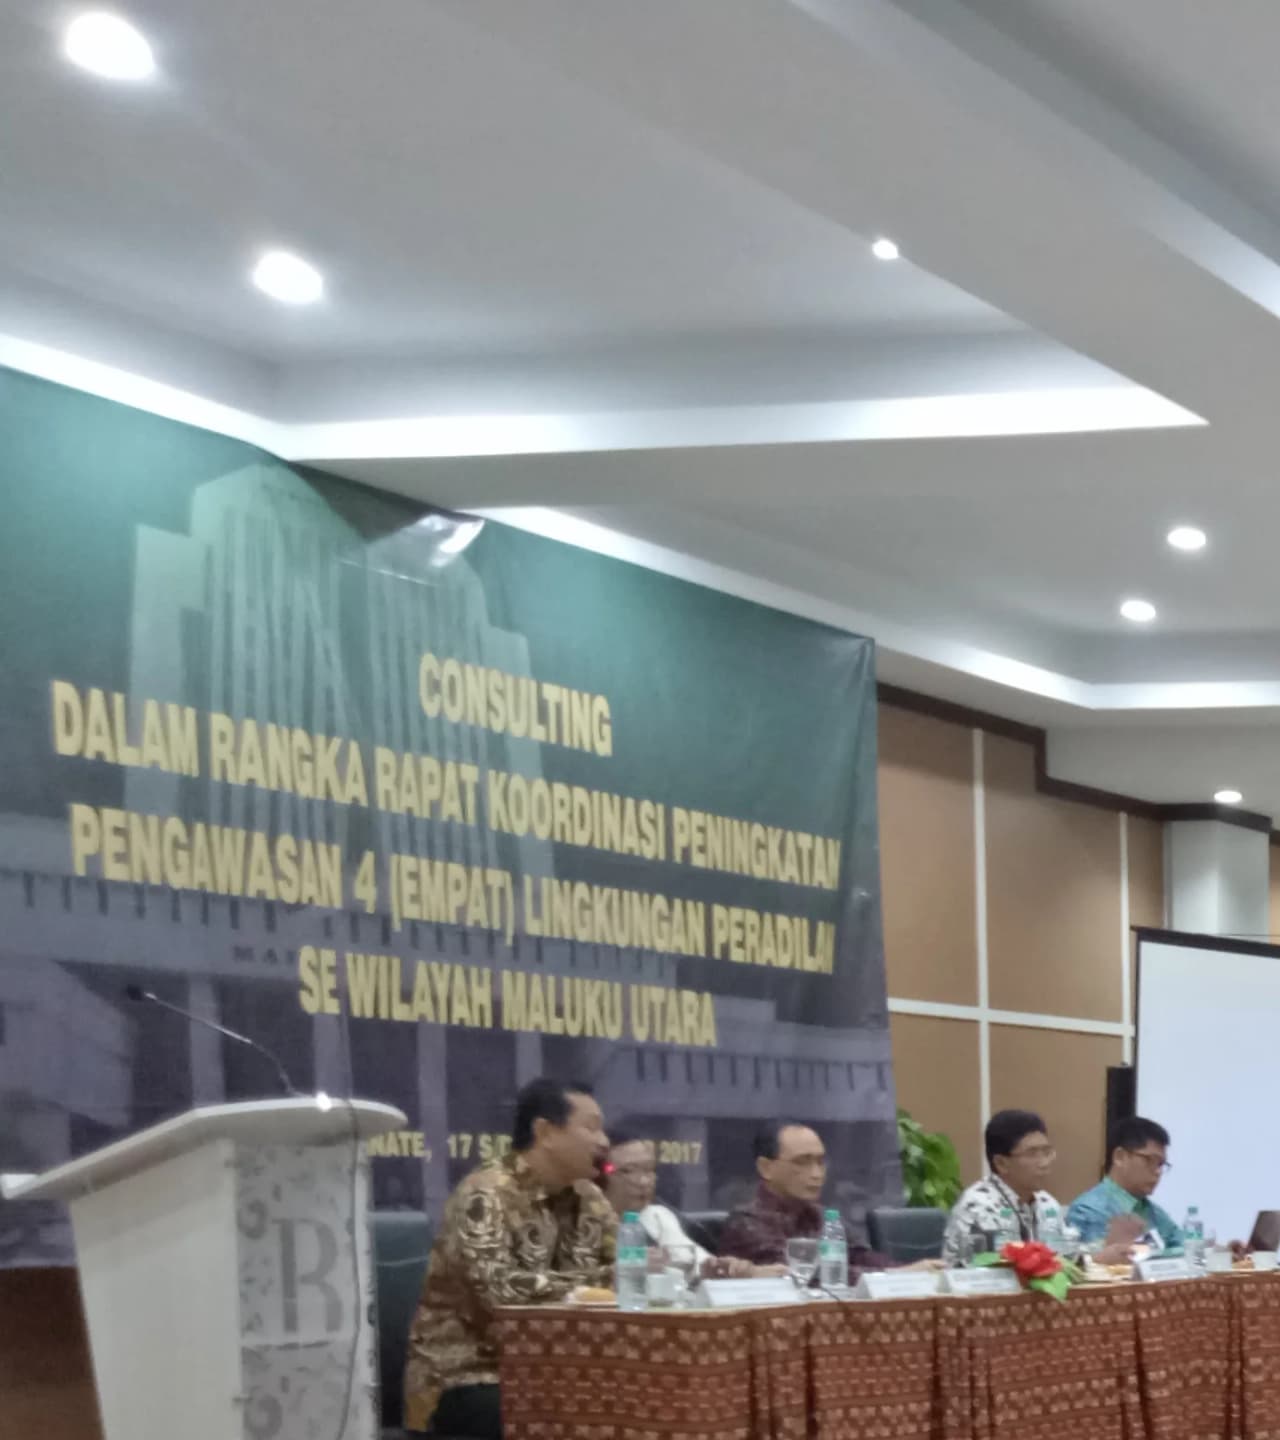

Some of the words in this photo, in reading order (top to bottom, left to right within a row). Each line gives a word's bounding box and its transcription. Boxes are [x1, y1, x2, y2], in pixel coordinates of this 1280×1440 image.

[419, 652, 612, 757] CONSULTING
[51, 679, 199, 777] DALAM
[209, 711, 369, 807] RANGKA
[373, 746, 479, 826] RAPAT
[487, 769, 667, 861] KOORDINASI
[672, 806, 842, 891] PENINGKATAN
[69, 803, 343, 909] PENGAWASAN
[352, 850, 377, 914] 4
[390, 853, 515, 947] (EMPAT)
[523, 874, 706, 957] LINGKUNGAN
[712, 903, 837, 976] PERADILAN
[298, 944, 342, 1015] SE
[344, 952, 494, 1029] WILAYAH
[502, 969, 624, 1040] MALUKU
[630, 983, 718, 1047] UTARA
[367, 1131, 432, 1163] NATE,
[447, 1133, 473, 1159] 17
[659, 1140, 703, 1165] 2017
